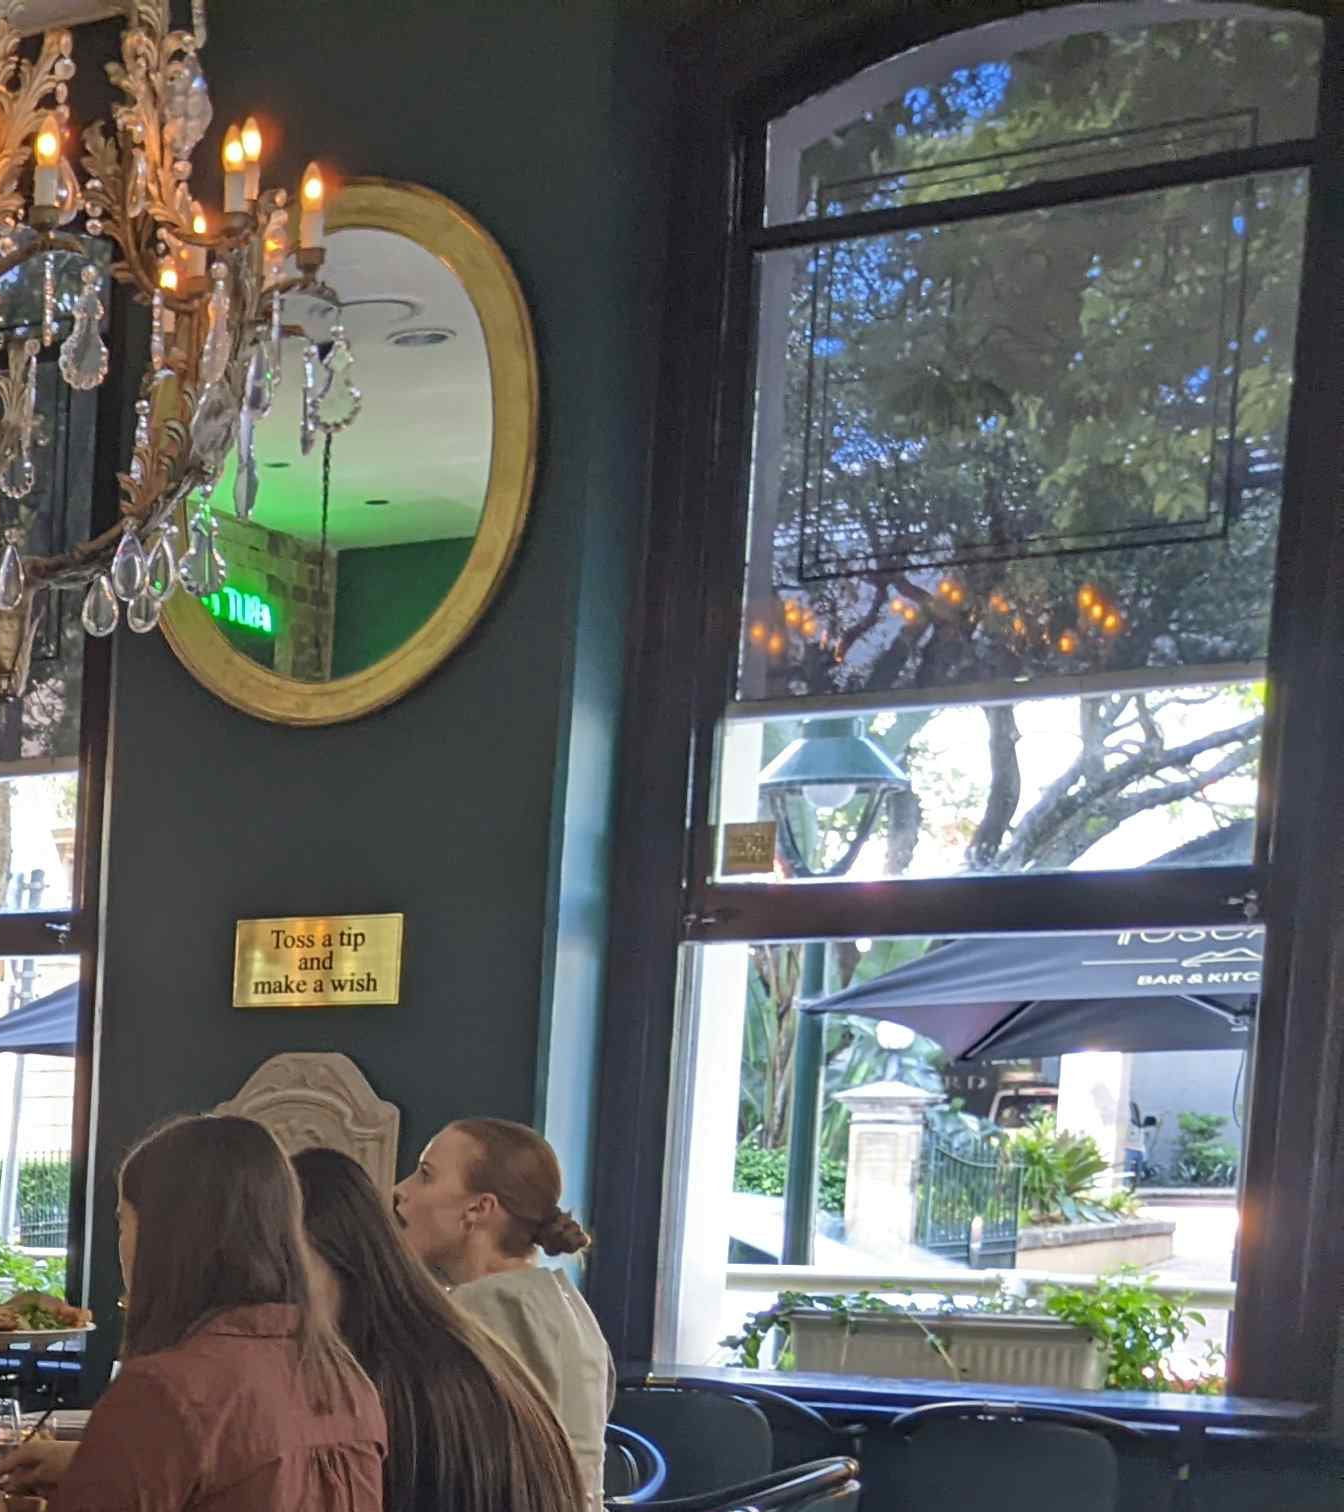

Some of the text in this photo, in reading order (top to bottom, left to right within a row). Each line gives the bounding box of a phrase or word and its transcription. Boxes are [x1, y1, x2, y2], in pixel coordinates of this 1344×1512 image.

[271, 927, 366, 952] Toss a tip
[297, 951, 333, 971] and
[253, 972, 378, 995] make a wish
[1136, 973, 1184, 986] BAR
[1186, 972, 1203, 984] &
